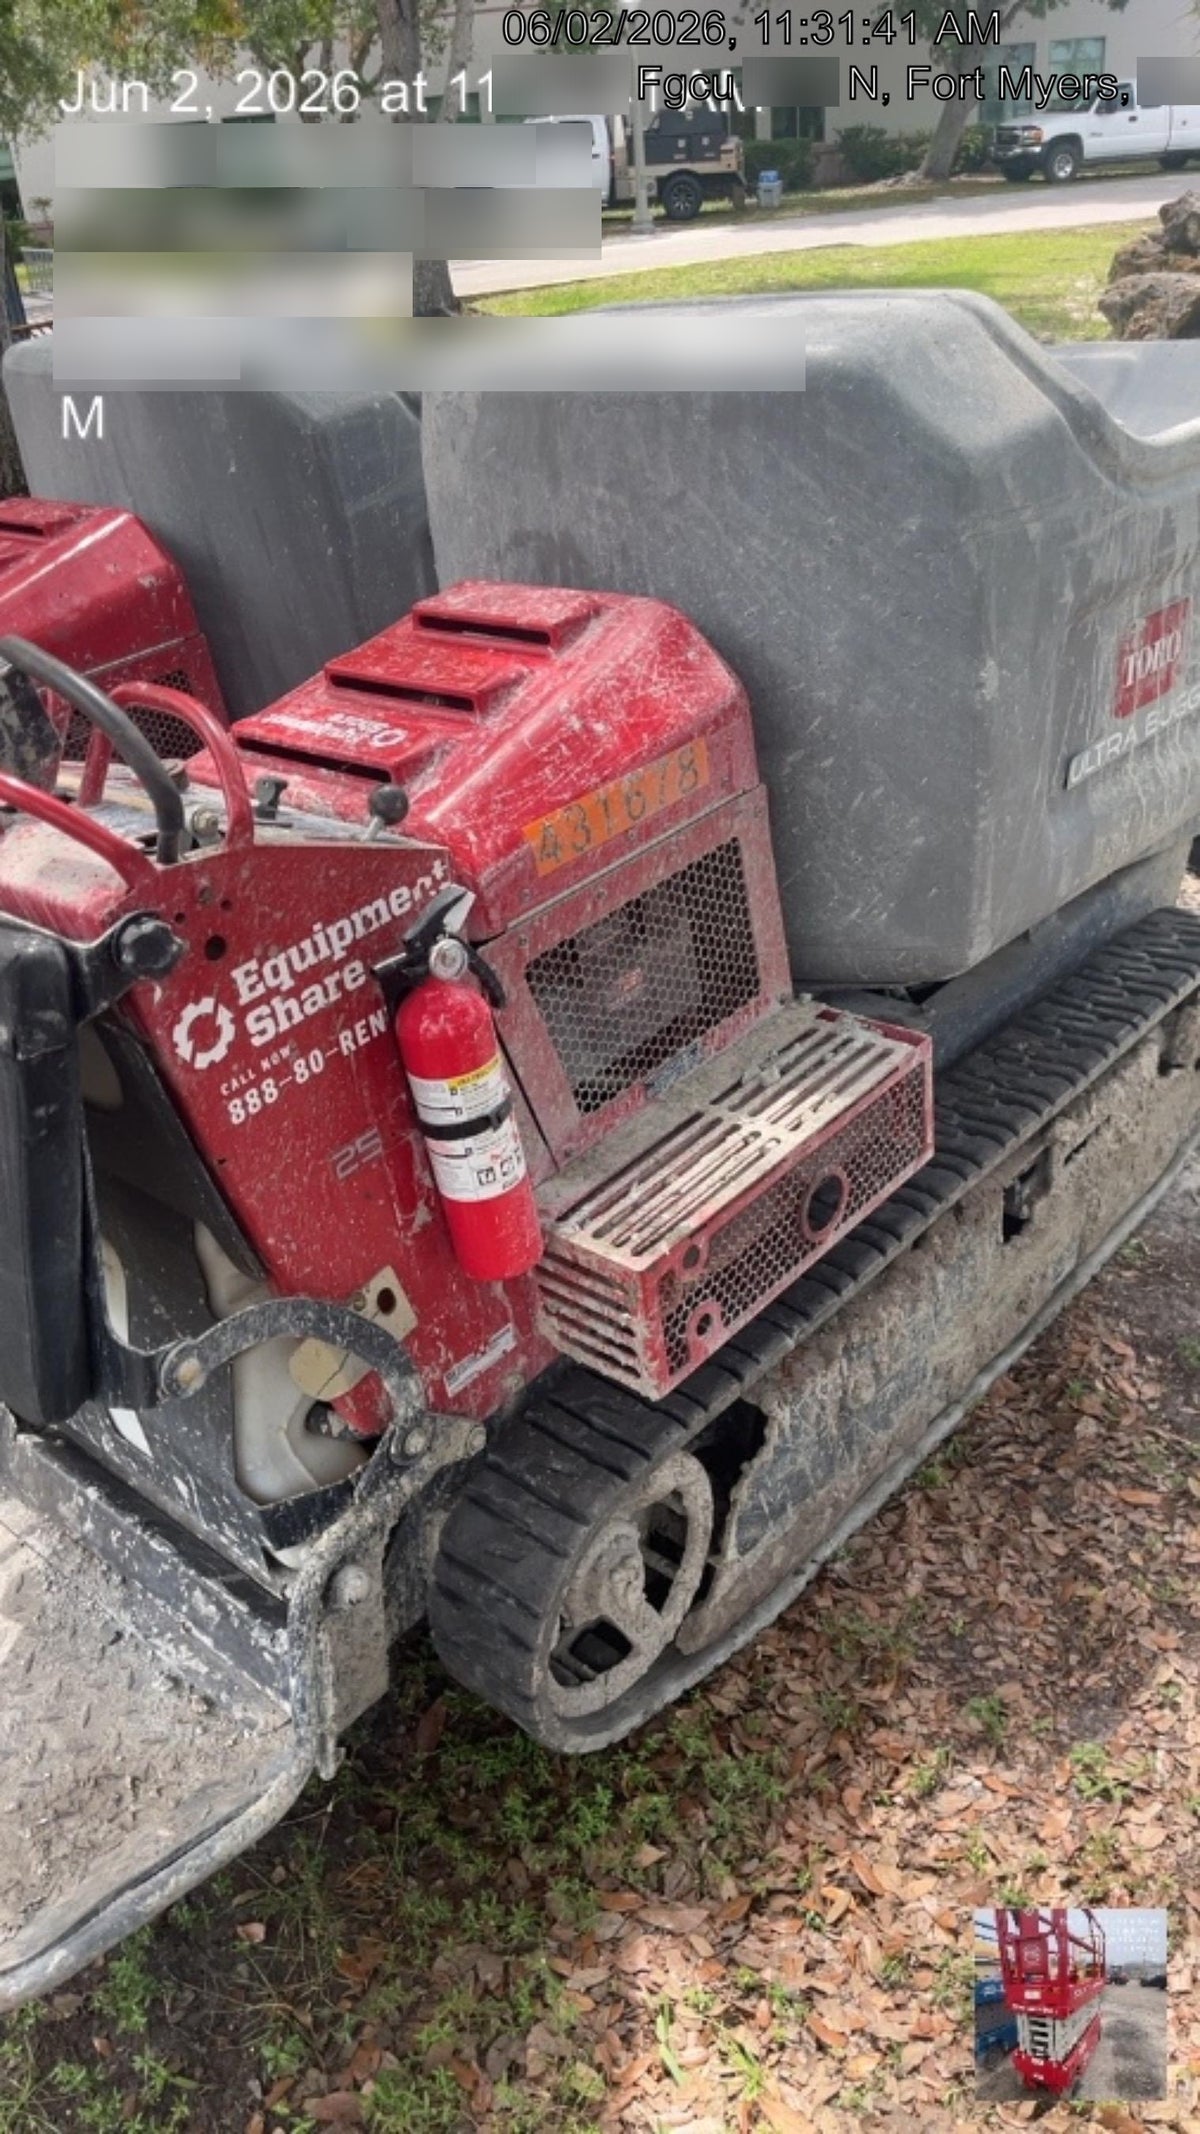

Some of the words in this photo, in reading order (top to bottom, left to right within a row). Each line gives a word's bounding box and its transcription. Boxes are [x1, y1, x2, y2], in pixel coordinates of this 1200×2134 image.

[1069, 725, 1138, 785] ULTRA
[245, 959, 368, 1048] Share
[220, 1070, 258, 1097] CALL
[227, 1007, 389, 1125] 888-80-REN
